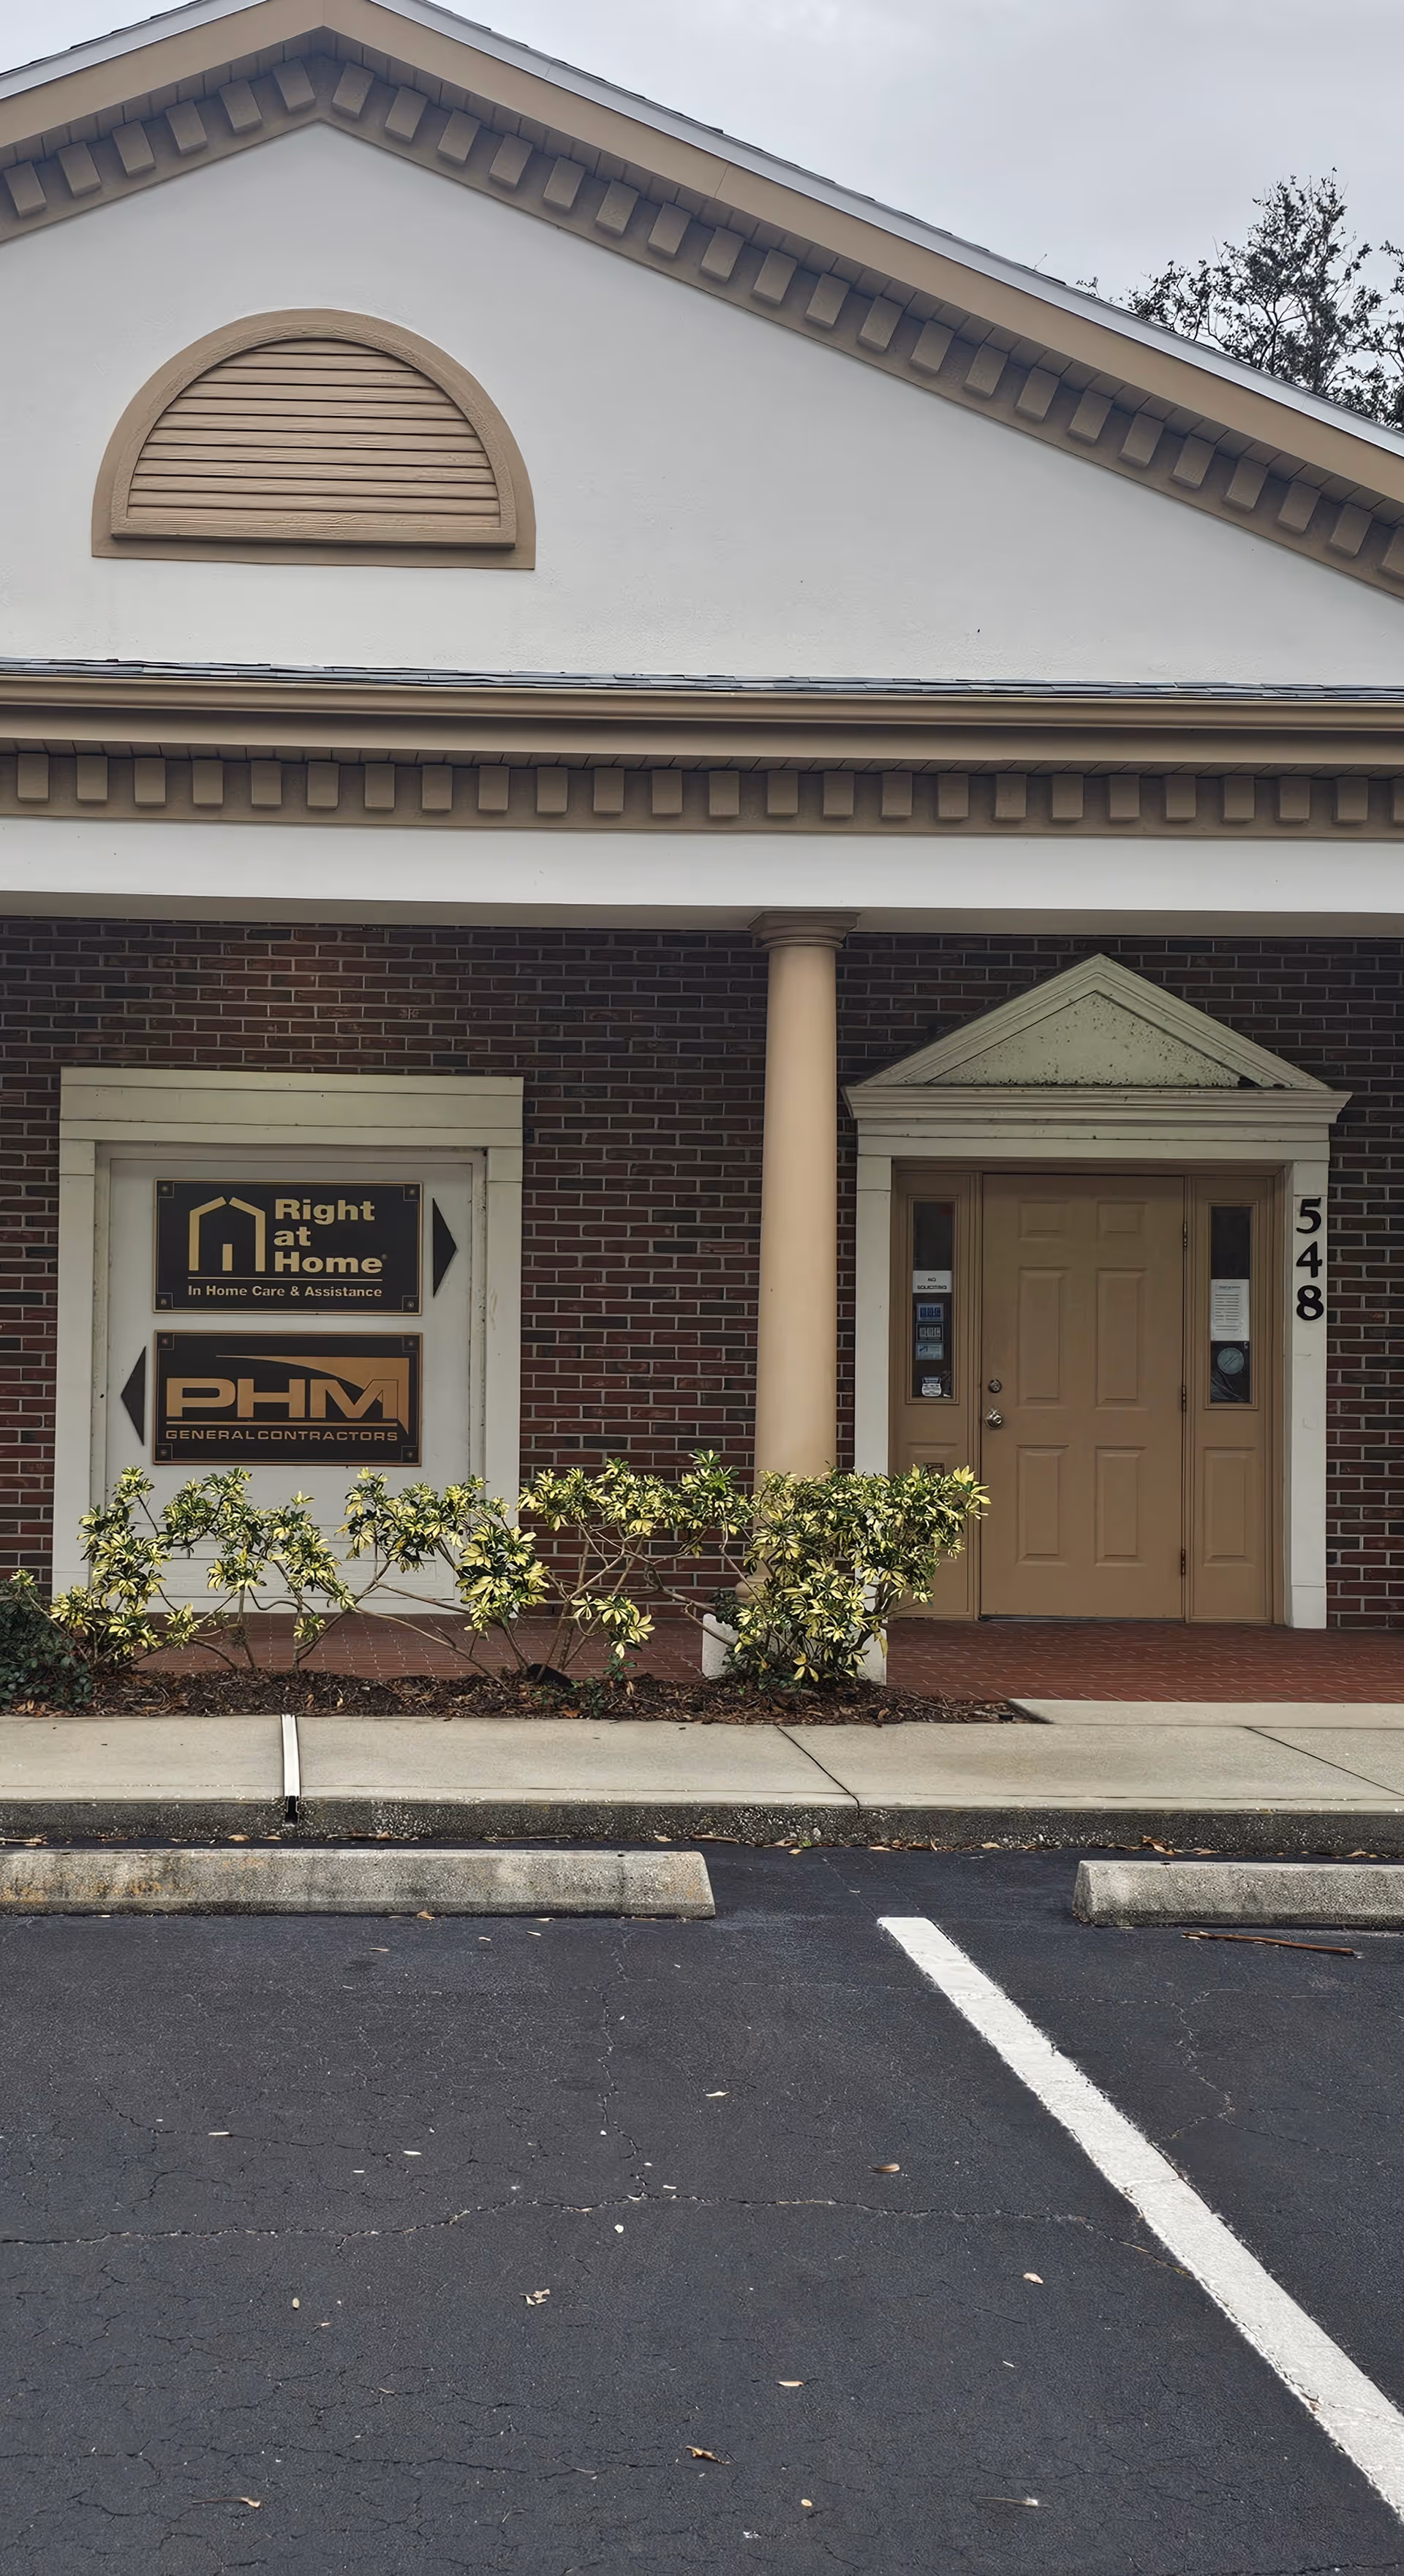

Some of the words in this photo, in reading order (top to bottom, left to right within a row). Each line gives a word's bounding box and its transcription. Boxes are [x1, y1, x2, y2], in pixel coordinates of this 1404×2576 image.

[275, 1198, 375, 1225] Right
[273, 1226, 312, 1246] at
[274, 1251, 383, 1274] Home
[1296, 1197, 1324, 1321] 548
[188, 1285, 201, 1296] In
[206, 1285, 247, 1296] Home
[252, 1286, 284, 1296] Care
[290, 1286, 300, 1296] &
[304, 1287, 382, 1297] Assistance
[166, 1378, 399, 1419] PHM
